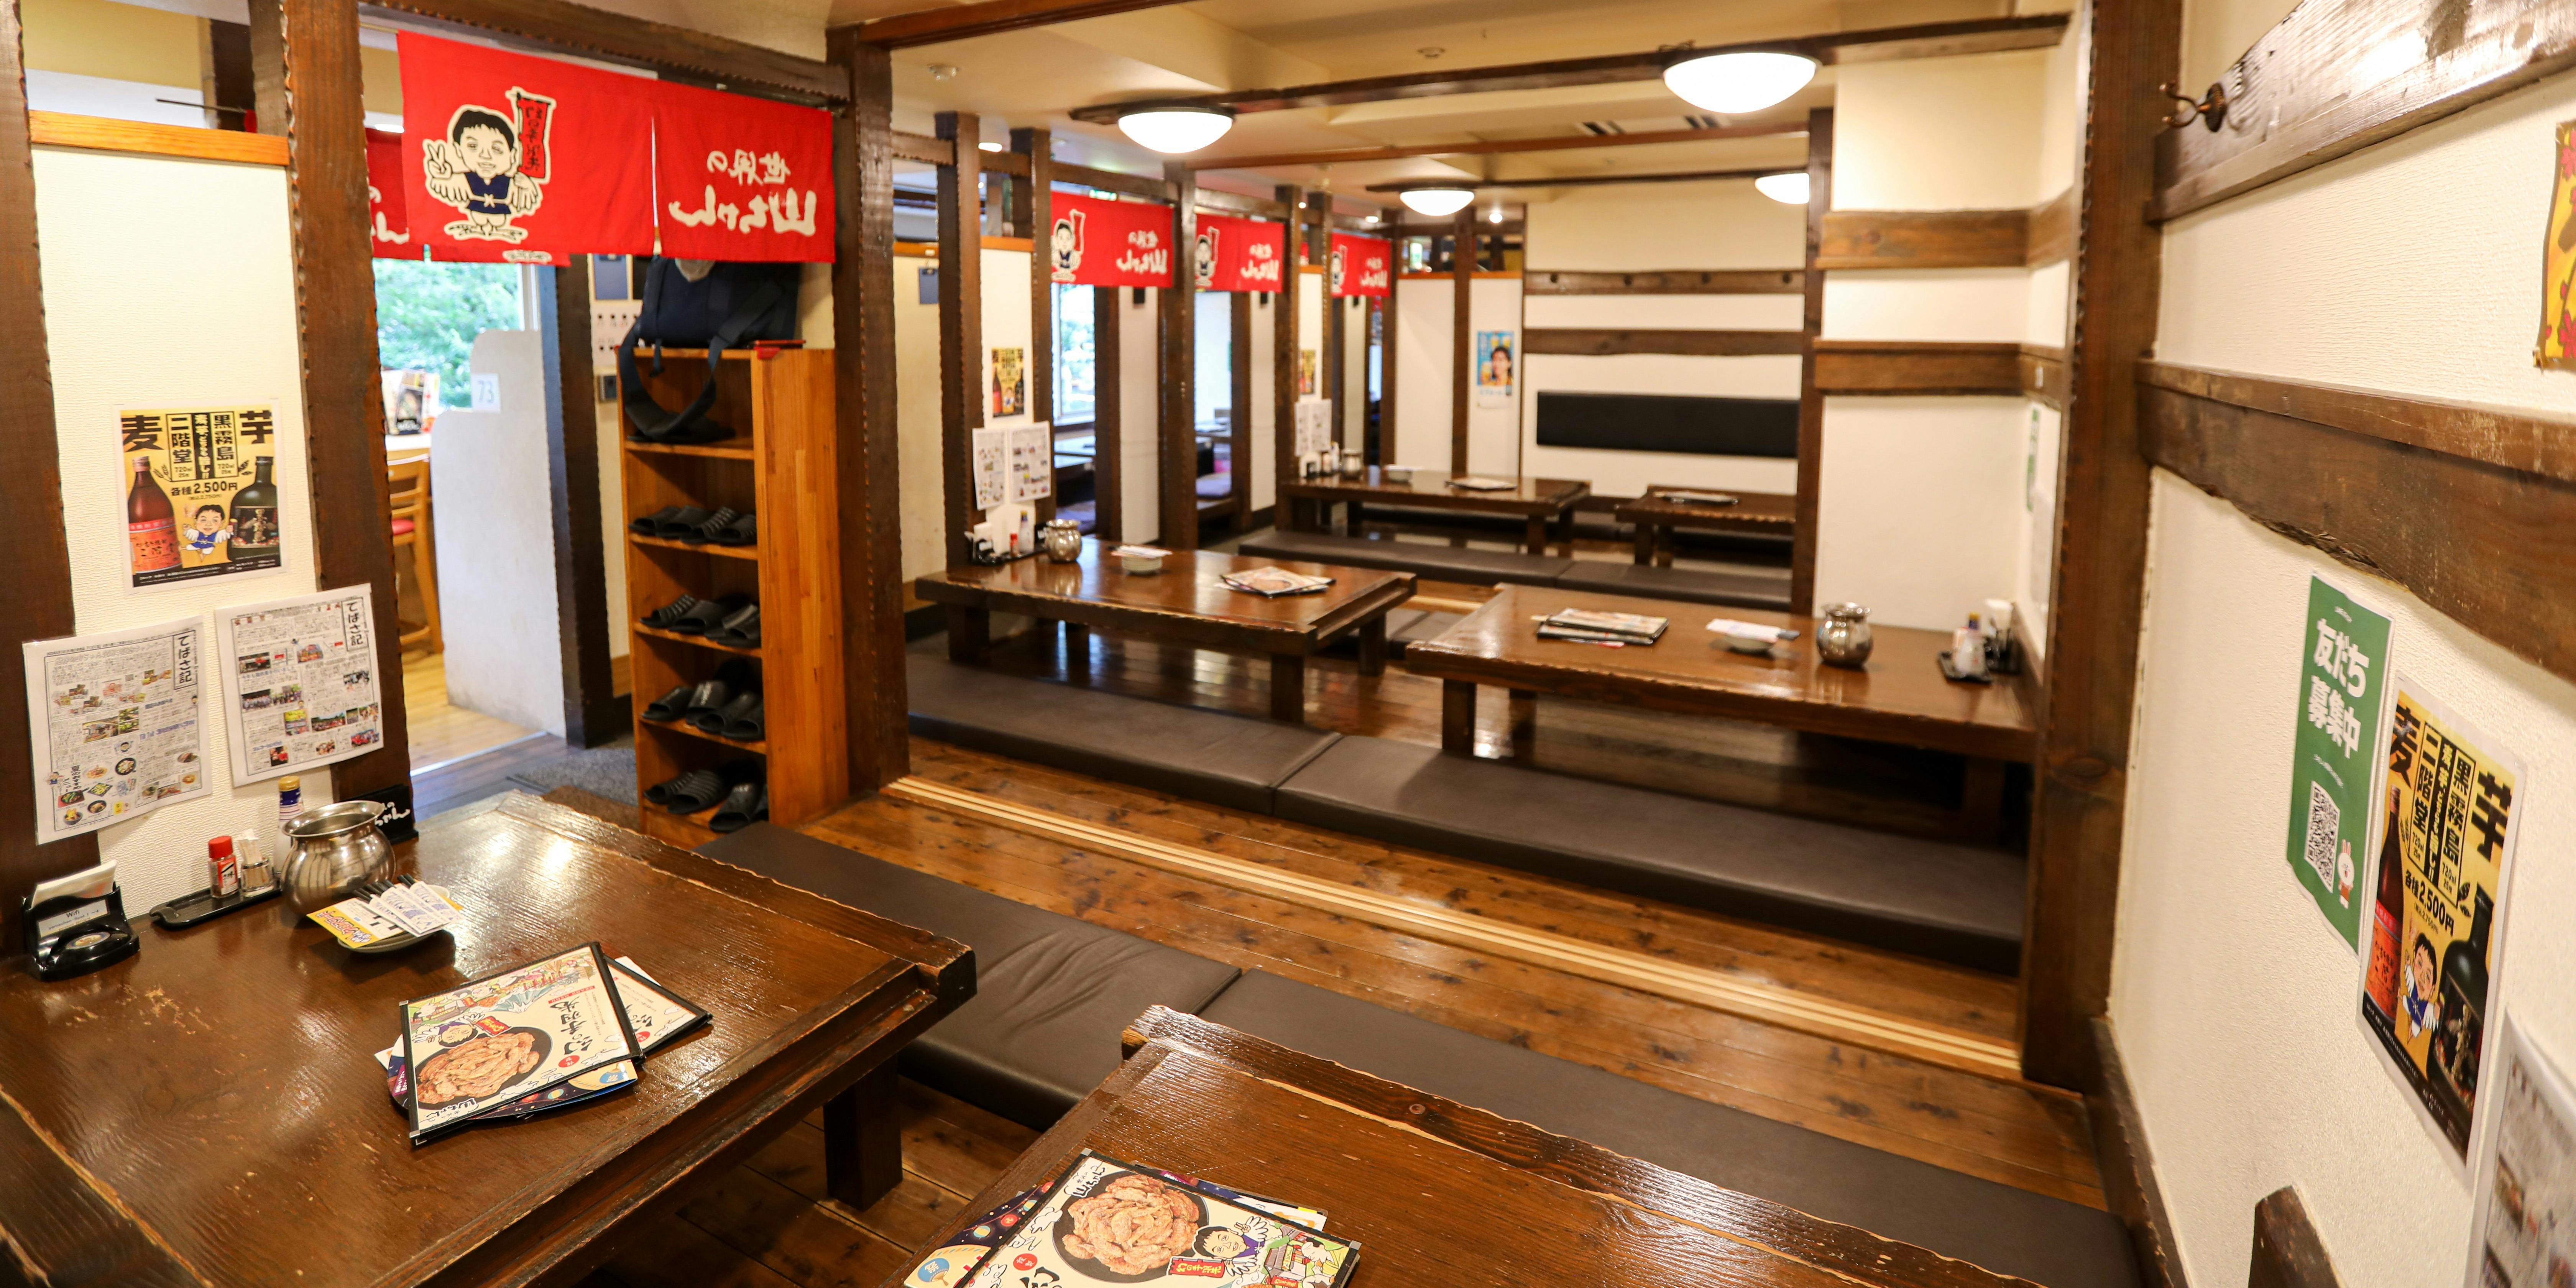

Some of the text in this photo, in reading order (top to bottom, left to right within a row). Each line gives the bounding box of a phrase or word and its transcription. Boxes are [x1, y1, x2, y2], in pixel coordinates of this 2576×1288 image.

[478, 380, 495, 404] 73
[121, 415, 164, 452] 麦
[171, 417, 191, 463] 二階堂
[214, 415, 234, 460] 黒霧島
[239, 411, 273, 444] 芋
[347, 602, 363, 646] てばさ記
[178, 635, 192, 684] てばさ記
[2314, 618, 2369, 698] 友だち
[2308, 675, 2361, 759] 募集中
[2390, 703, 2421, 789] 麦
[2413, 733, 2438, 835] 二階堂
[2443, 756, 2471, 866] 黒霧島
[2471, 770, 2512, 863] 芋
[549, 997, 592, 1056] 幻の手羽先
[426, 1099, 476, 1119] 山ちゃん
[1073, 1167, 1105, 1196] 山ちゃん
[1176, 1262, 1222, 1275] 幻の手羽先
